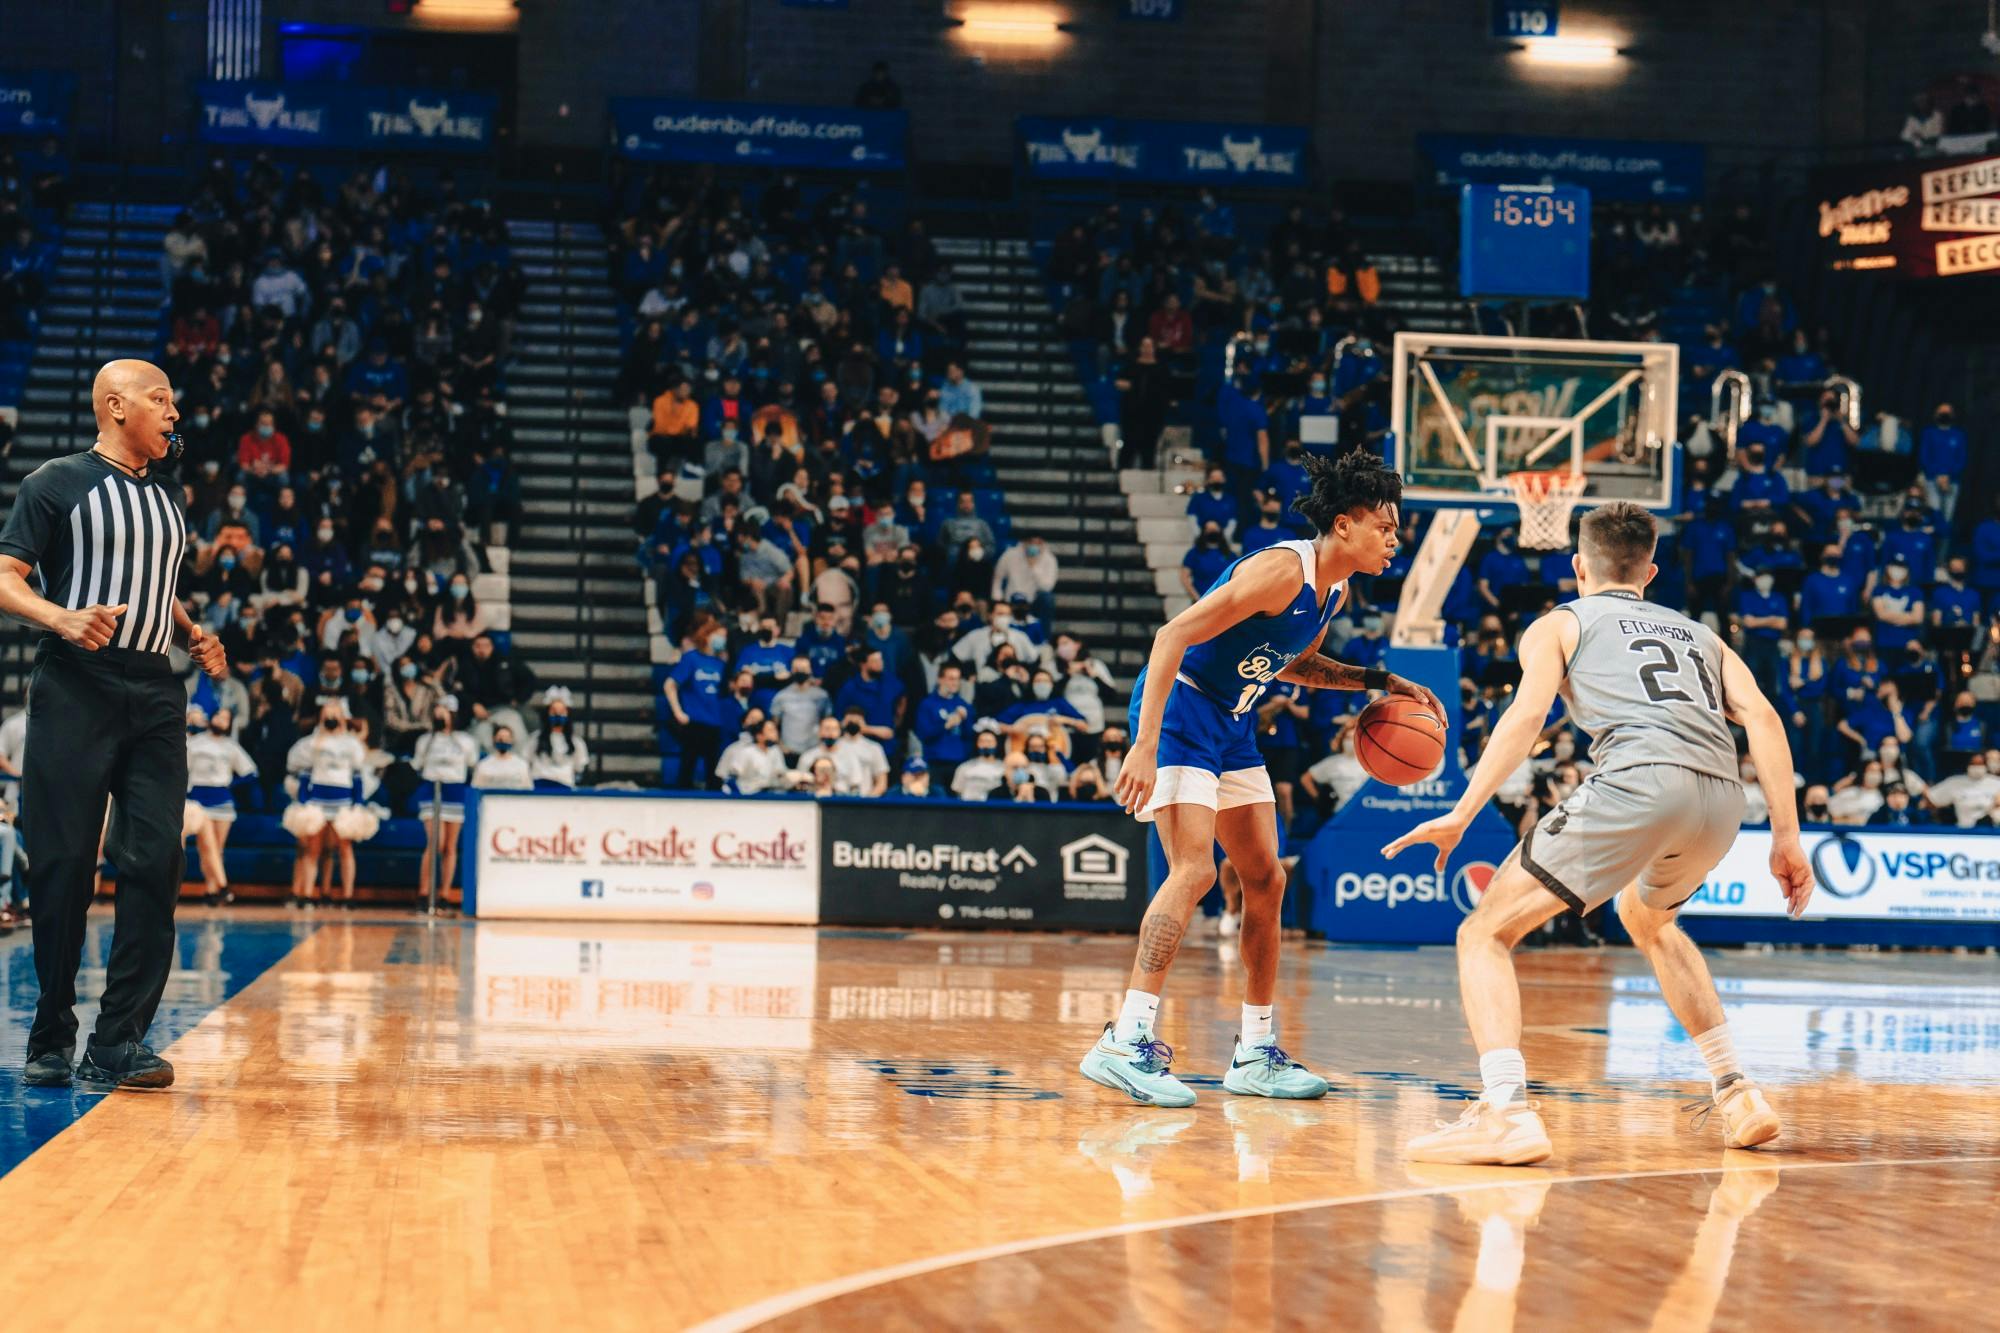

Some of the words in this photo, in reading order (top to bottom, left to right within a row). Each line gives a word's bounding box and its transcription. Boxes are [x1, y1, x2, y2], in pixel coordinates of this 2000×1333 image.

[1507, 9, 1548, 34] 110
[652, 114, 863, 140] audenbuffalo.com
[1493, 194, 1575, 227] 16:04
[1616, 618, 1697, 645] ETCHISON
[1627, 637, 1720, 713] 21
[491, 824, 588, 859] Castle
[601, 826, 698, 861] Castle
[710, 829, 807, 864] Castle
[832, 841, 1000, 872] BuffaloFirst
[899, 872, 947, 892] Realty
[1334, 872, 1447, 909] pepsi
